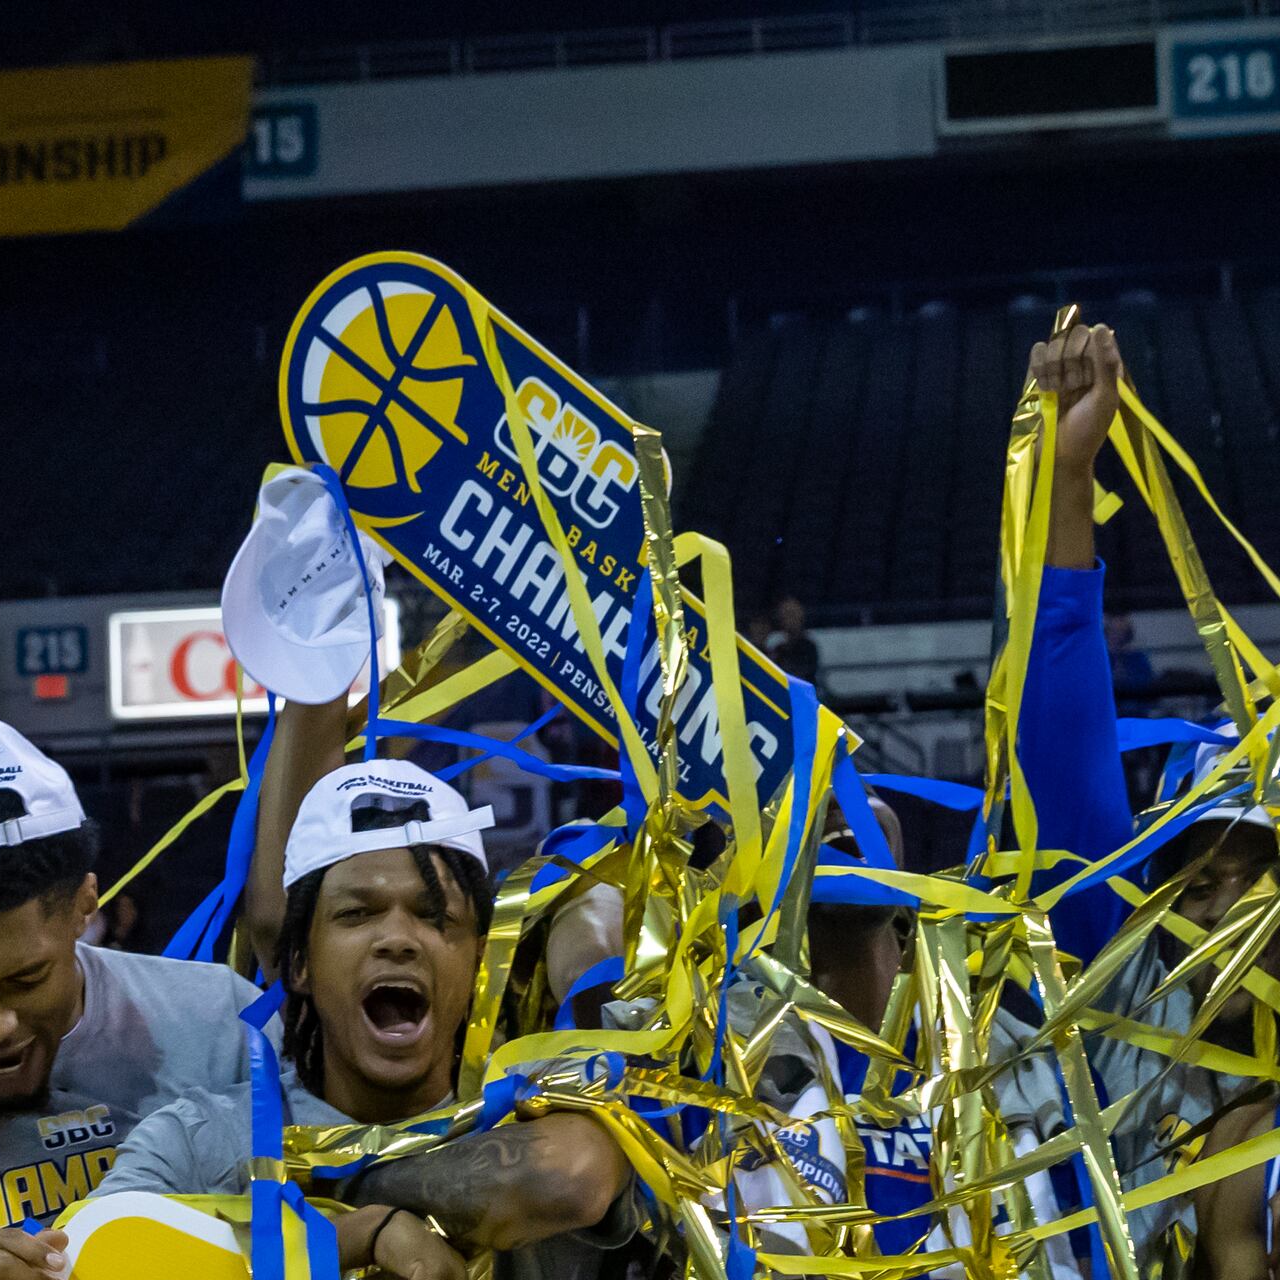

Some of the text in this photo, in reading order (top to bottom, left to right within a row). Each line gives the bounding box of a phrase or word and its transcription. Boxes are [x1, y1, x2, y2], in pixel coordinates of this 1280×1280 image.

[1187, 52, 1276, 103] 216
[254, 115, 306, 165] 15
[494, 376, 639, 529] SBC
[476, 452, 532, 506] MEN
[422, 543, 464, 591] MAR.
[470, 582, 501, 622] 2-7,
[506, 615, 550, 659] 2022
[368, 774, 434, 793] BASKETBALL
[37, 1103, 115, 1150] SBC
